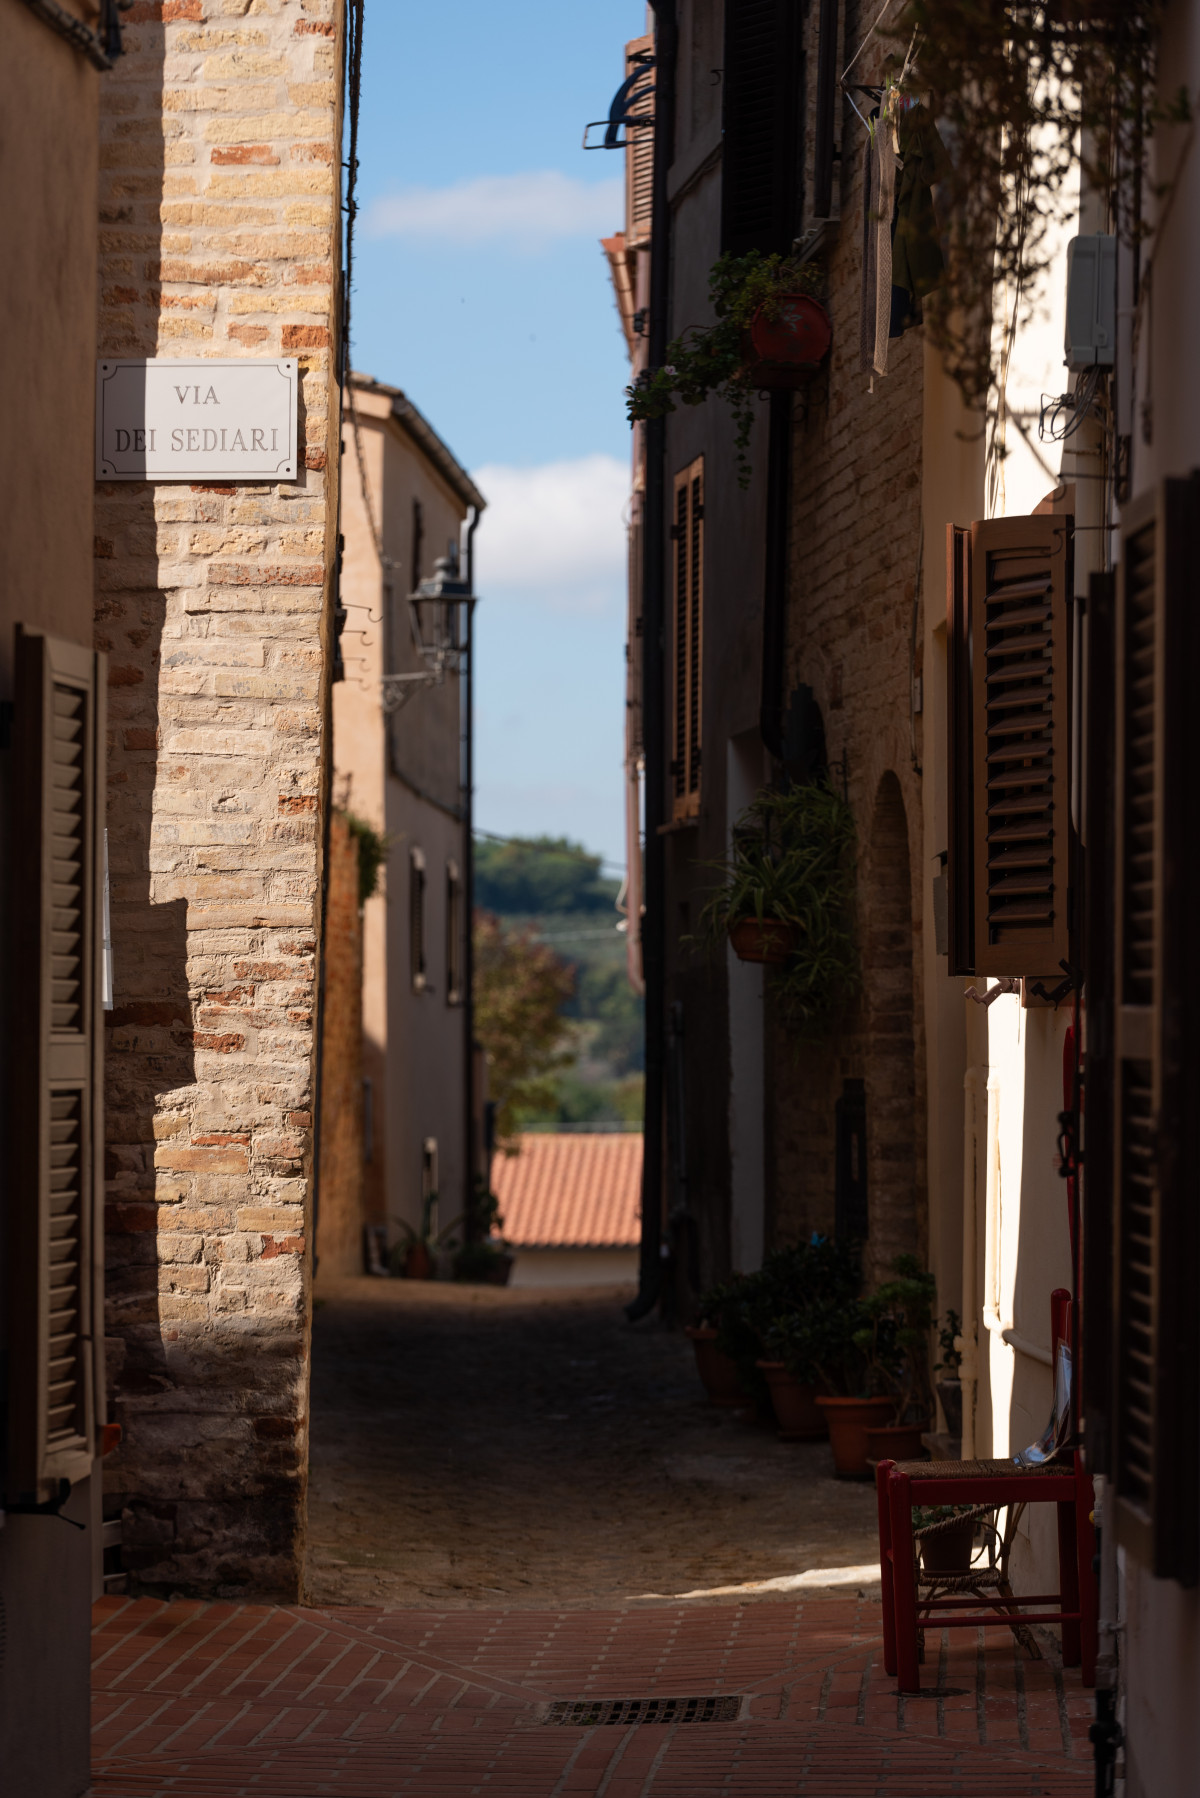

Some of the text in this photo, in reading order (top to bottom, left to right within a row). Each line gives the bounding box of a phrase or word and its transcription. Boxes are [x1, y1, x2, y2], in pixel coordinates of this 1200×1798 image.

[174, 386, 221, 405] VIA
[115, 428, 279, 452] DEI SEDIARI
